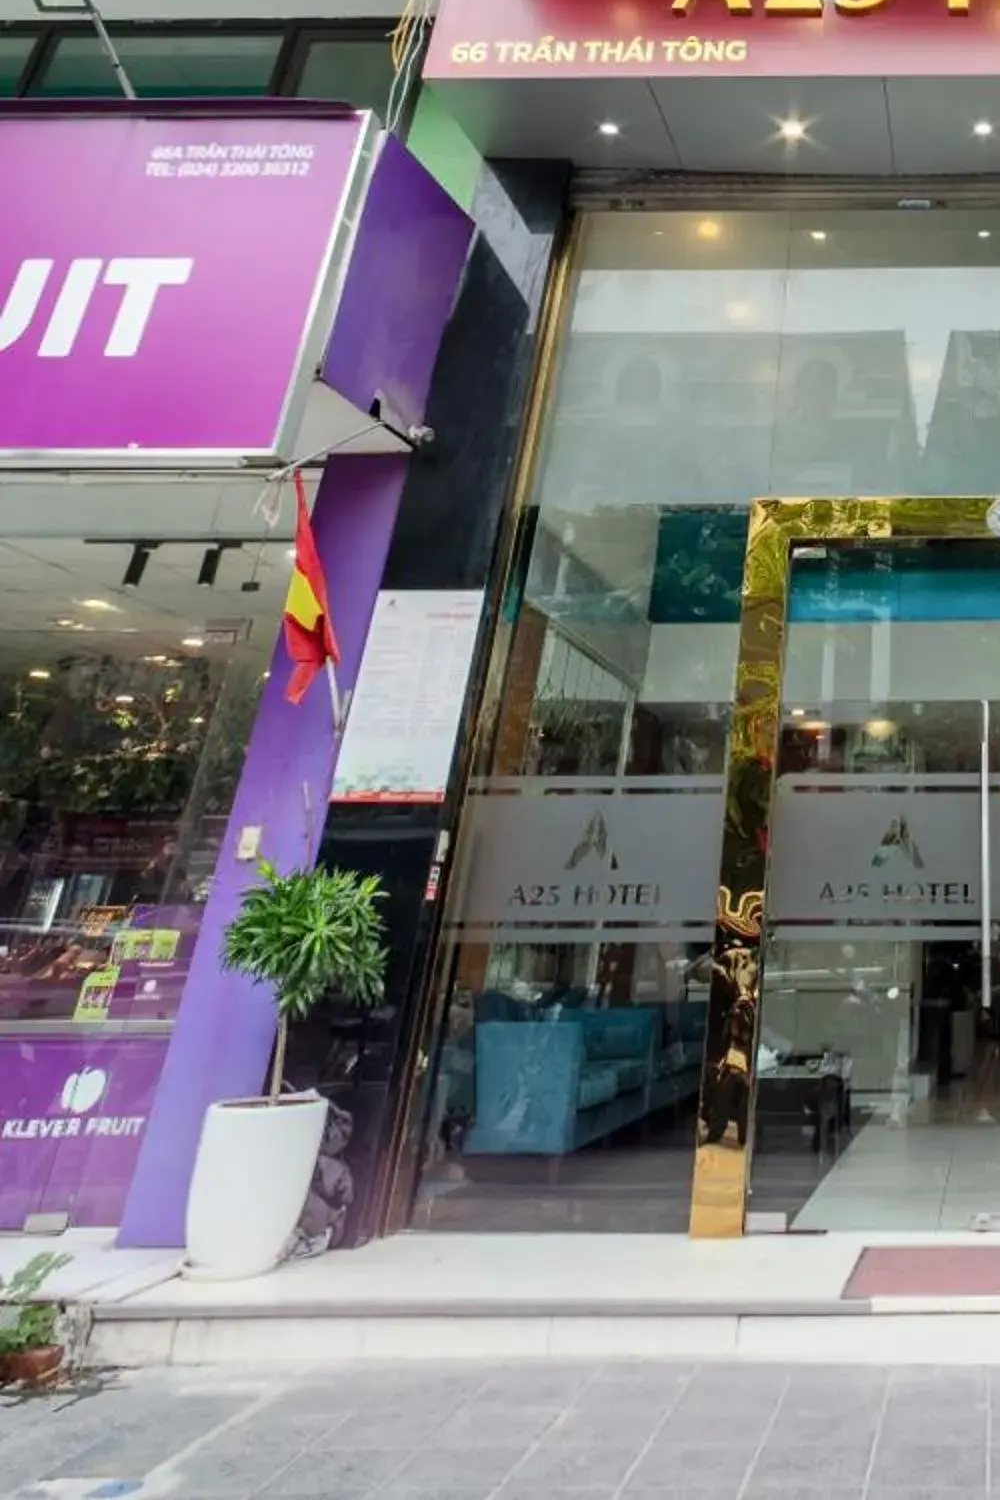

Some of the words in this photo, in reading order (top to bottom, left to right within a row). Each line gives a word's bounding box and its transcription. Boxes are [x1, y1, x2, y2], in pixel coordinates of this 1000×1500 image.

[451, 41, 488, 63] 66
[496, 35, 576, 63] TRẦN
[583, 38, 654, 63] THÁI
[662, 35, 748, 63] TÔNG
[508, 884, 561, 906] A25
[1, 1116, 81, 1139] KLEVER
[84, 1115, 146, 1137] FRUIT
